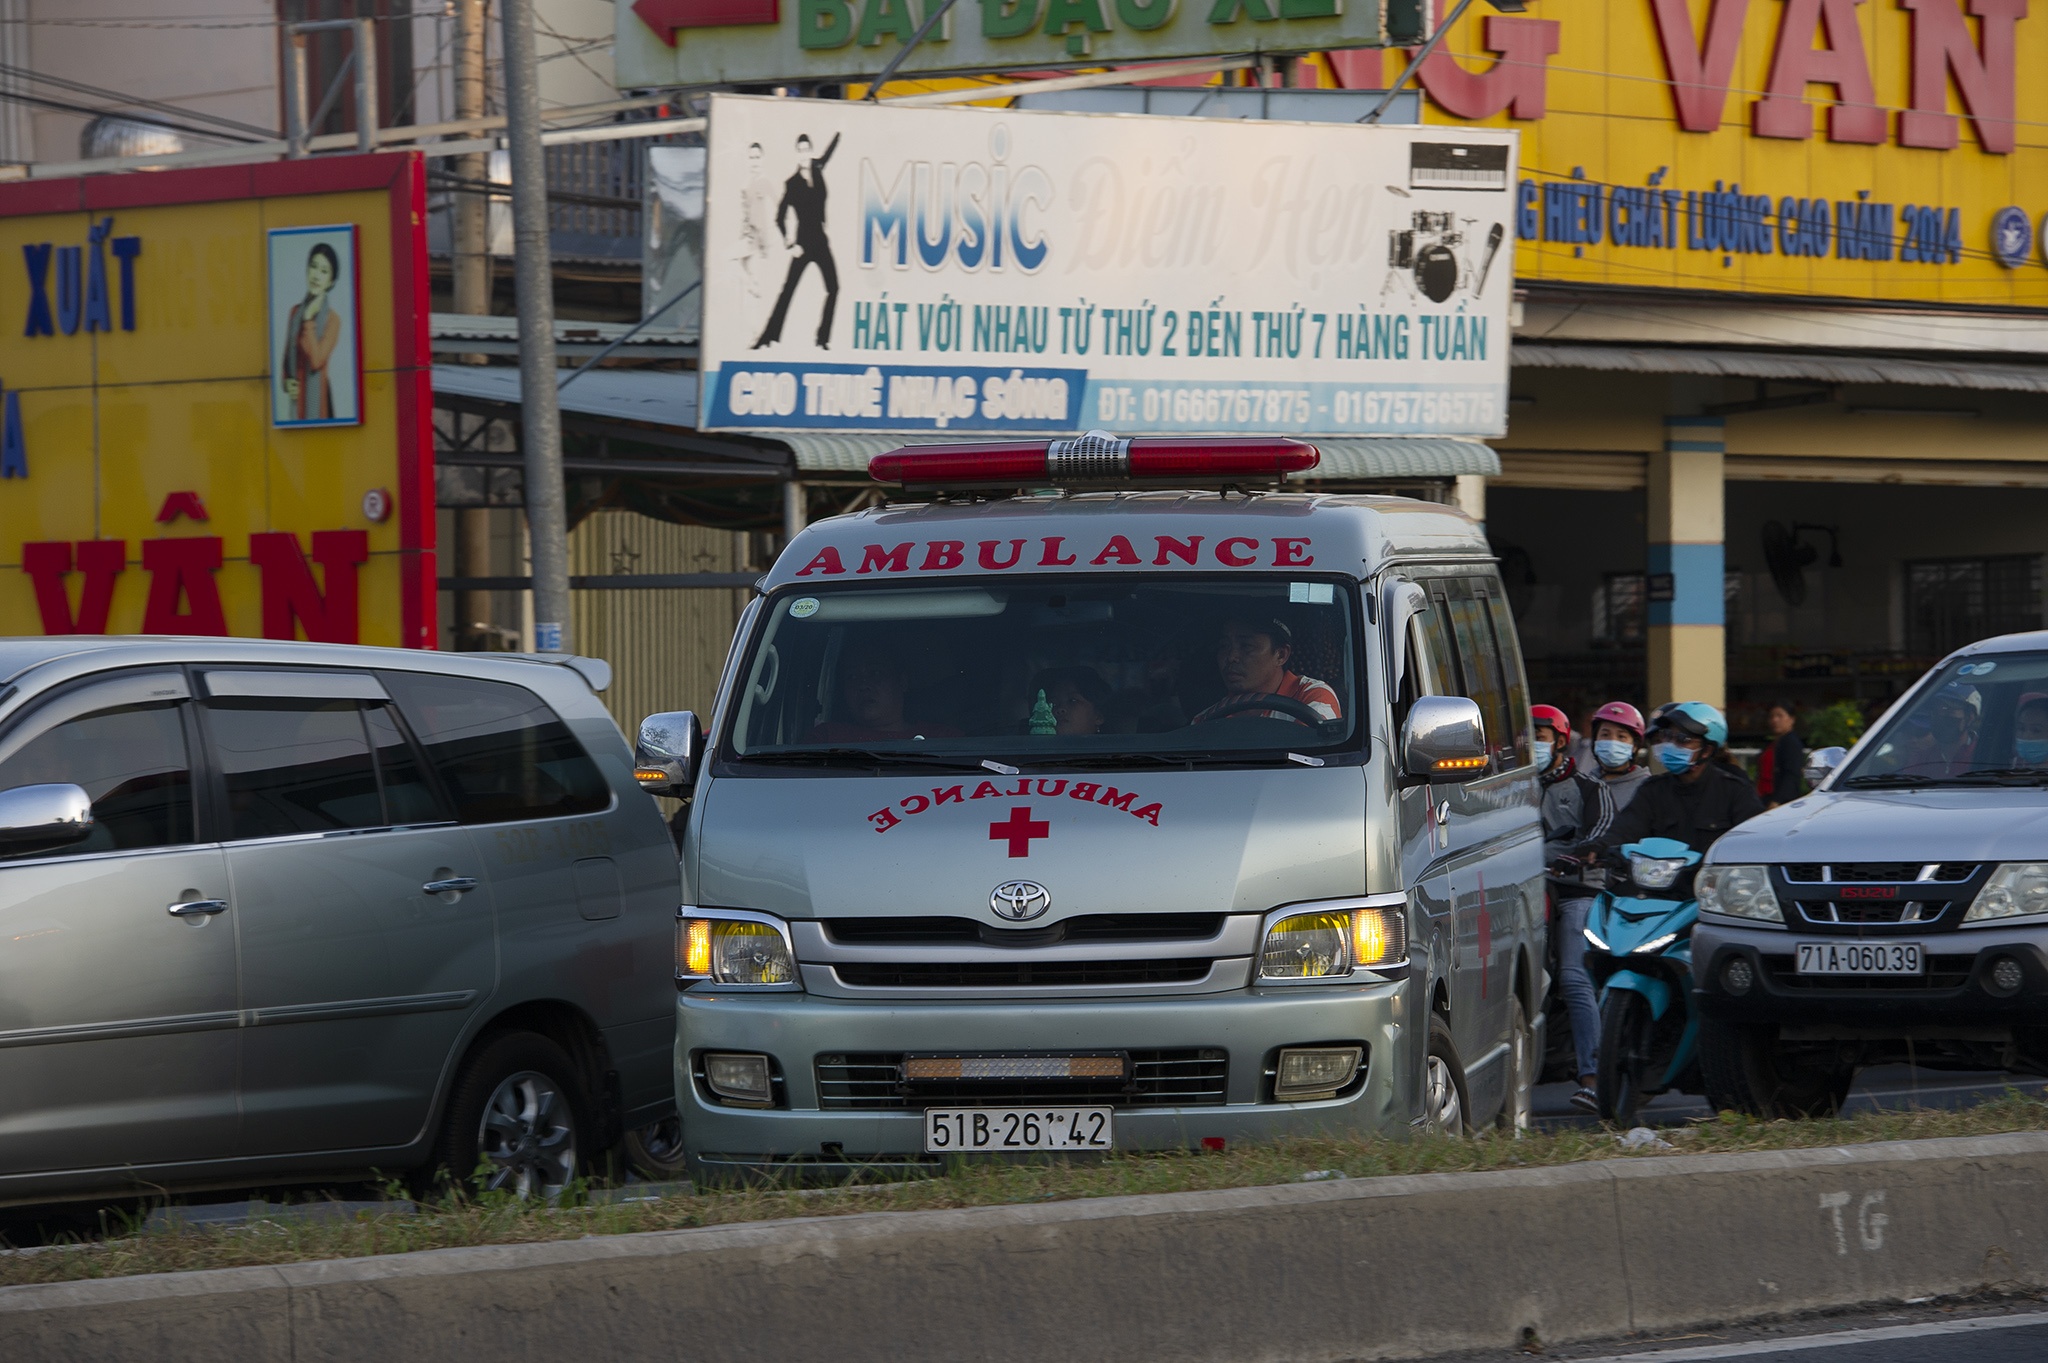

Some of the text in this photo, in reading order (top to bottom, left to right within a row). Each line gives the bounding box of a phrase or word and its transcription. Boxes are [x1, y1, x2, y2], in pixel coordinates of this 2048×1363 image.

[1245, 153, 1378, 290] Hẹn
[1544, 166, 1603, 258] HIỆU
[1609, 166, 1682, 248] CHẤT
[1688, 180, 1773, 268] LƯỢNG
[1779, 196, 1831, 257] CAO
[1836, 190, 1894, 261] NĂM
[1901, 204, 1963, 264] 2014
[22, 216, 142, 338] XUẤT
[852, 292, 1488, 362] HÁT VỚI NHAU TỪ THỨ 2 ĐẾN THỨ 7 HÀNG TUẦN
[729, 366, 1069, 428] CHO THUÊ NHẠC SÓNG
[1097, 387, 1136, 422] ĐT:
[22, 491, 369, 642] VÂN
[795, 535, 1315, 577] AMBULANCE
[1840, 887, 1896, 898] ISUZU
[1801, 946, 1917, 971] 71A-060.39
